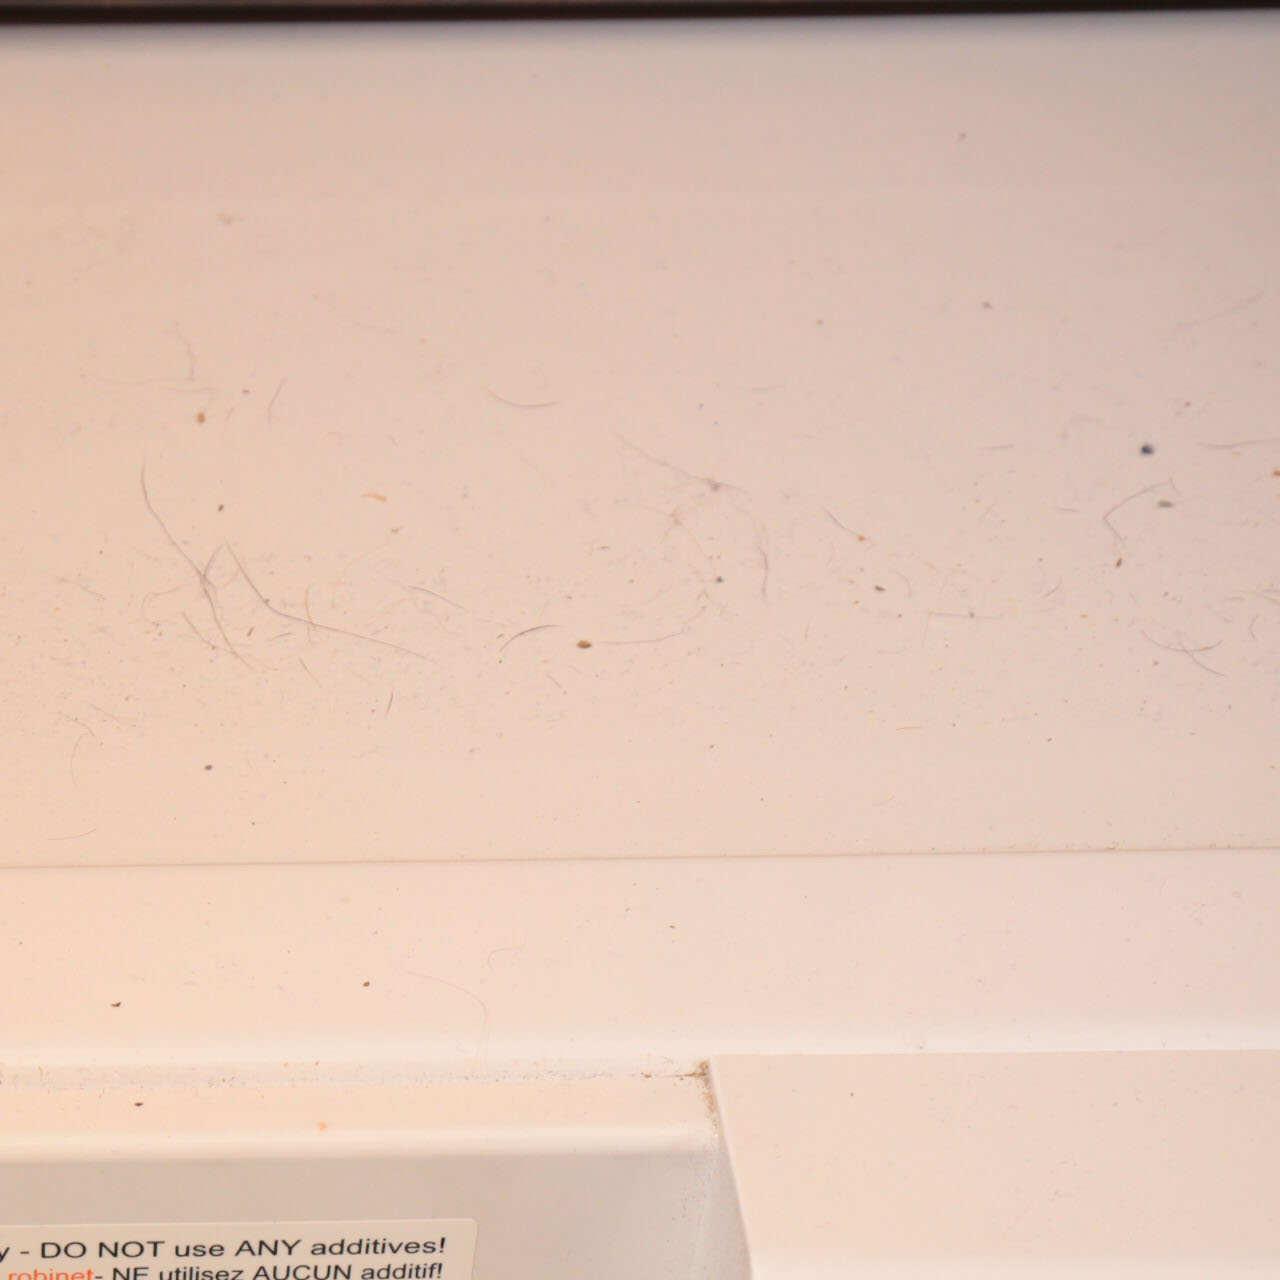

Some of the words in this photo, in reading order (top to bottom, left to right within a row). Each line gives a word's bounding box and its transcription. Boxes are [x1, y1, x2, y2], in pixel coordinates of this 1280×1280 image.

[41, 1242, 87, 1258] DO
[99, 1241, 165, 1258] NOT
[175, 1245, 224, 1257] use
[235, 1240, 301, 1256] ANY
[311, 1237, 445, 1255] additives!
[252, 1264, 352, 1280] AUCUN
[361, 1263, 442, 1280] additif!
